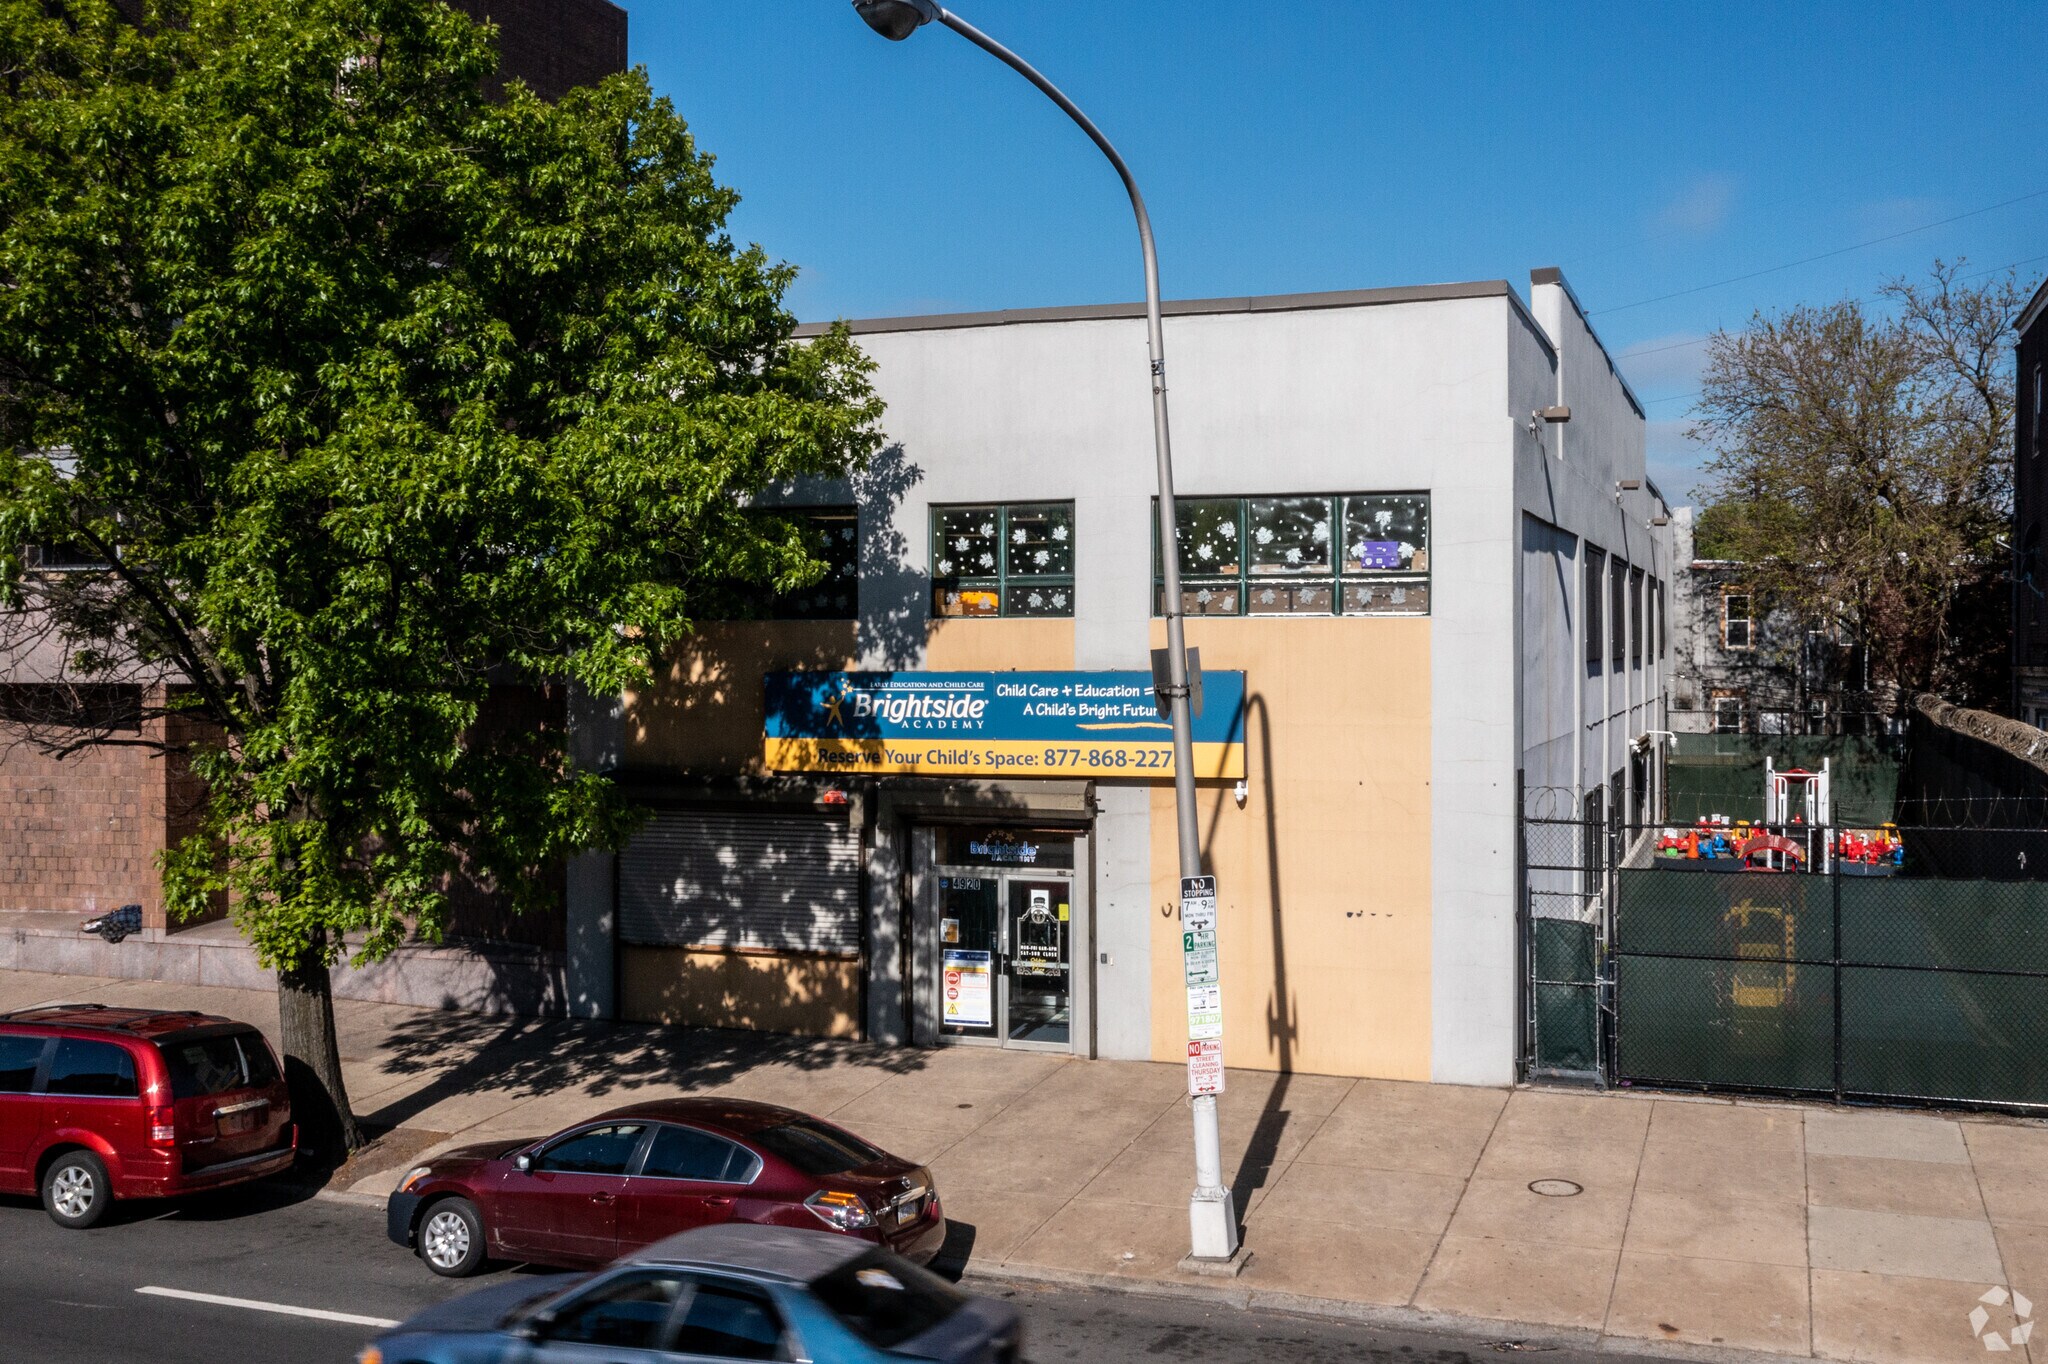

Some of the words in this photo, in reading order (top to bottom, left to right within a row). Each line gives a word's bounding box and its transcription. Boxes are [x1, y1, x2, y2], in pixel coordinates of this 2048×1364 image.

[870, 681, 889, 689] EARLY
[889, 681, 927, 689] EDUCATION
[928, 681, 943, 689] AND
[944, 681, 966, 689] CHILD
[967, 681, 985, 689] CARE
[996, 684, 1027, 697] Child
[1029, 684, 1058, 697] Care
[1075, 684, 1140, 698] Education
[853, 693, 985, 724] Brightside
[1023, 706, 1034, 716] A
[1036, 702, 1076, 717] Child's
[1078, 703, 1120, 719] Bright
[1123, 704, 1158, 717] Futur
[901, 720, 985, 729] ACADEMY
[818, 748, 880, 764] Reserve
[885, 749, 922, 765] Your
[926, 749, 981, 765] Child's
[985, 750, 1039, 769] Space:
[1044, 748, 1175, 768] 877-868-227
[970, 840, 1036, 856] Brightside
[953, 878, 981, 890] 4920
[1191, 878, 1205, 889] NO
[1184, 888, 1214, 898] STOPPING
[1184, 901, 1190, 911] 7
[1201, 899, 1208, 910] 9
[1186, 935, 1193, 949] 2
[1194, 940, 1215, 949] PARKING
[1190, 1014, 1221, 1025] 971807
[1189, 1043, 1200, 1055] NO
[1201, 1043, 1220, 1052] PARKING
[1192, 1061, 1219, 1069] CLEANING
[1191, 1067, 1221, 1076] THURSDAY
